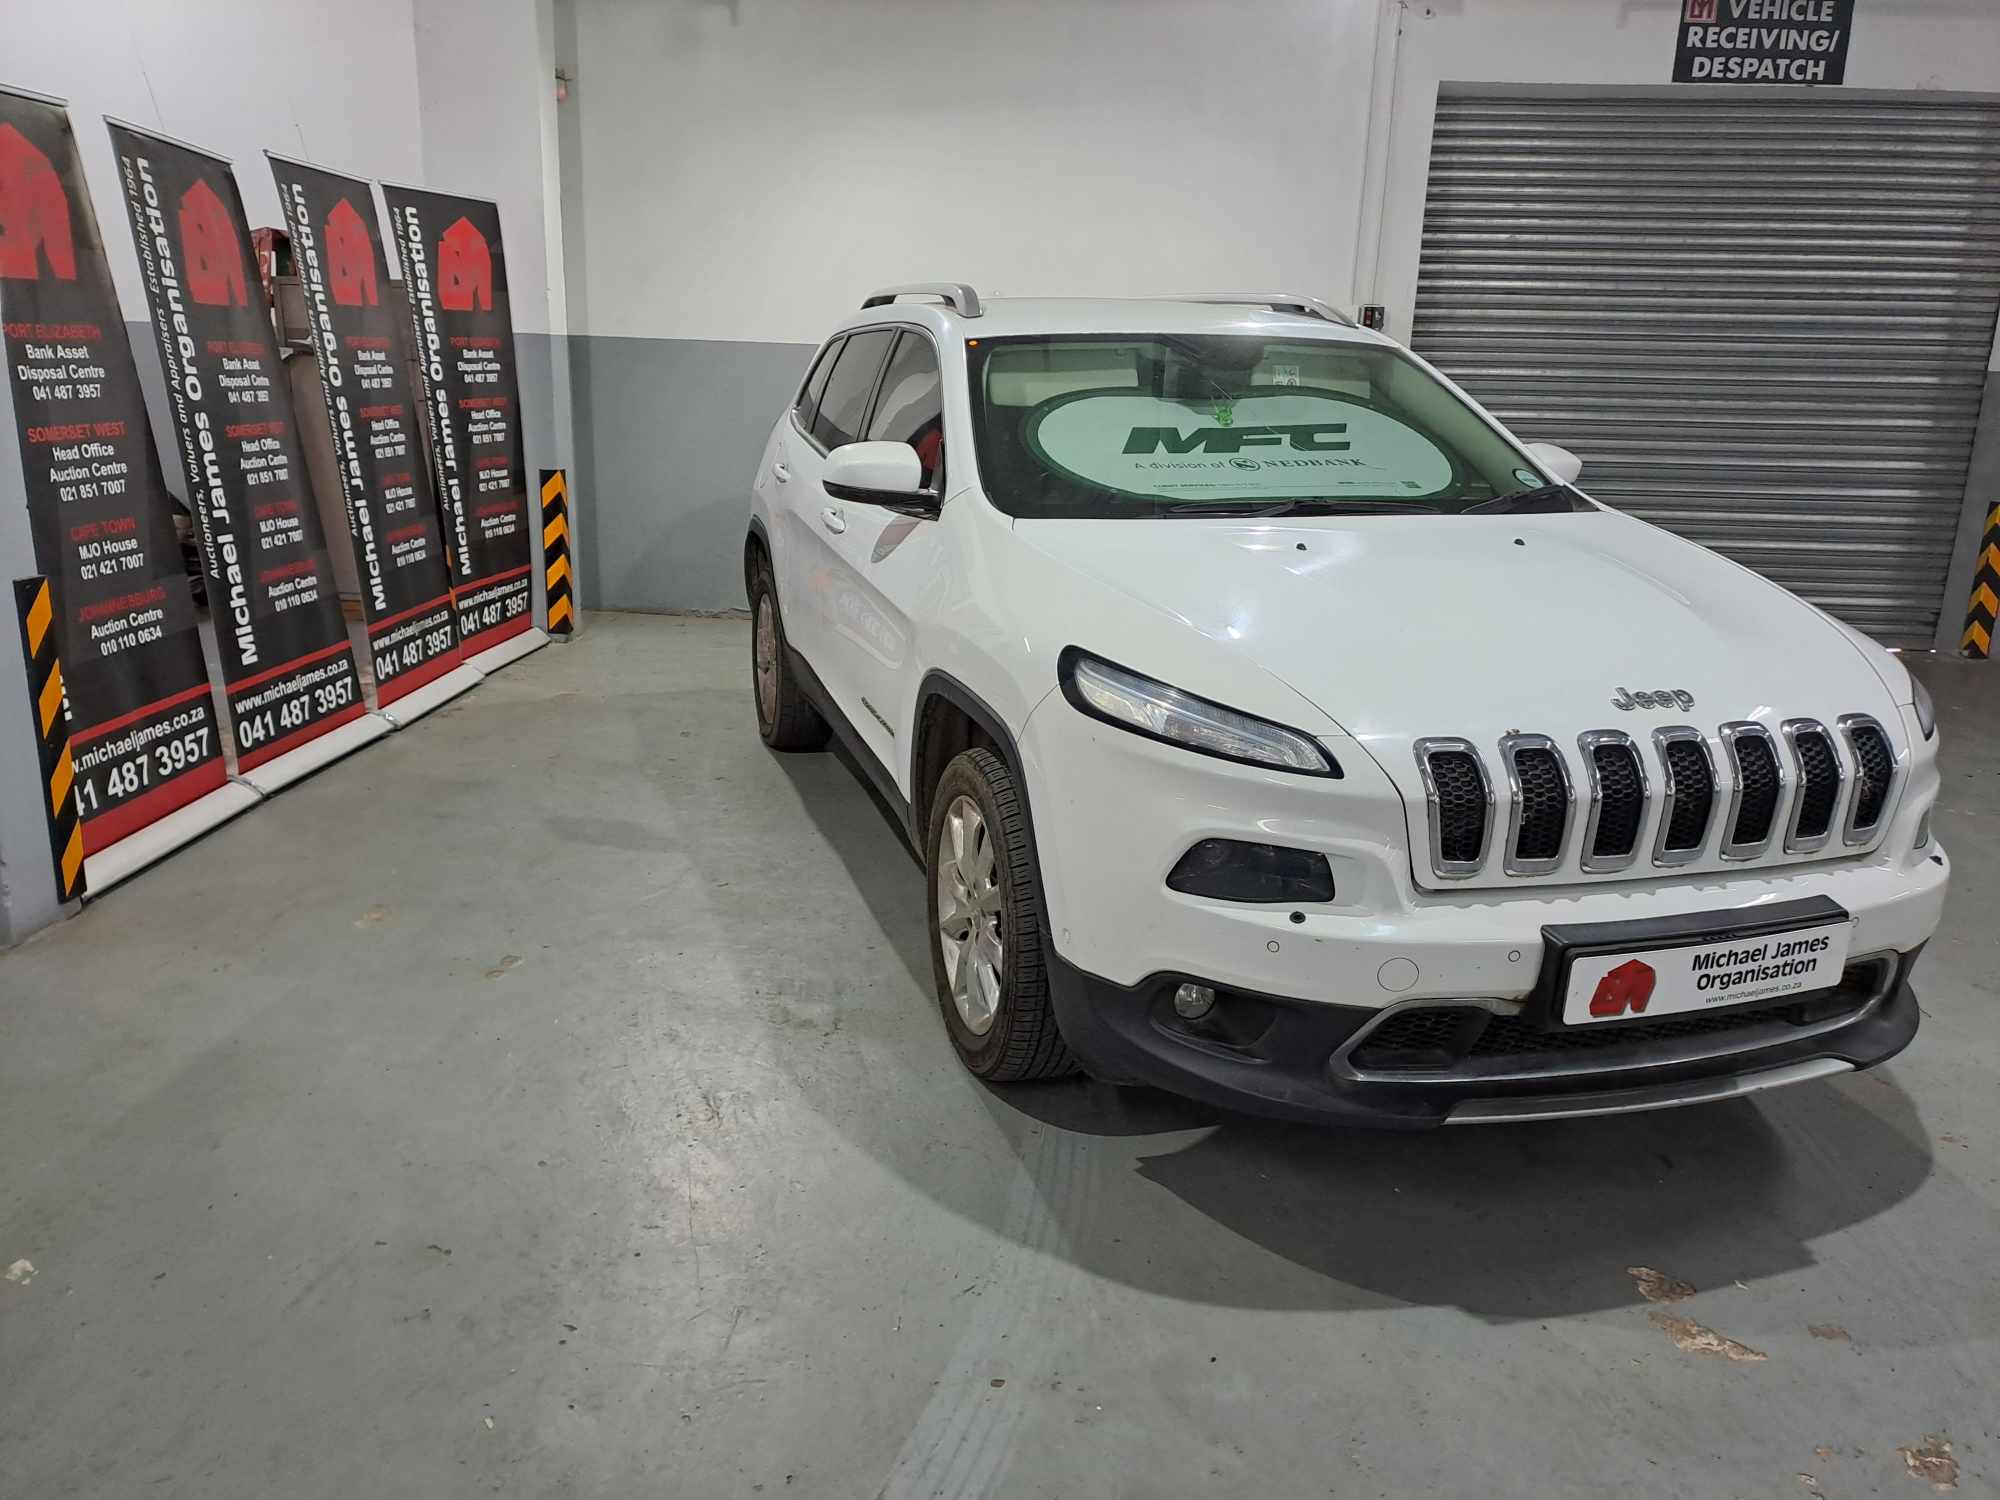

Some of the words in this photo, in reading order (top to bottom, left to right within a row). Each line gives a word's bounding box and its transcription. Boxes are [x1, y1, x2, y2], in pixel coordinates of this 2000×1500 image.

[1729, 0, 1834, 21] VEHICLE
[1686, 26, 1840, 52] RECEIVING/
[1691, 56, 1826, 81] DESPATCH
[130, 200, 159, 292] Established
[25, 344, 54, 359] Bank
[56, 344, 89, 359] Asset
[157, 307, 182, 389] Appraisers
[17, 365, 67, 382] Disposal
[69, 364, 105, 379] Centre
[218, 374, 251, 389] Disposal
[33, 386, 51, 401] 041
[54, 385, 72, 400] 487
[78, 383, 101, 398] 3957
[173, 393, 188, 424] and
[95, 421, 127, 437] WEST
[336, 395, 364, 491] James
[436, 389, 457, 472] James
[1122, 423, 1351, 454] MFC
[52, 446, 79, 462] Head
[81, 443, 114, 457] Office
[183, 427, 199, 484] Valuers
[195, 411, 231, 524] James
[1149, 460, 1202, 470] division
[1263, 457, 1367, 468] NEDBANK
[50, 466, 89, 483] Auction
[92, 461, 128, 477] Centre
[60, 487, 78, 502] 021
[79, 483, 98, 499] 851
[101, 479, 126, 495] 7007
[448, 478, 472, 576] Michael
[79, 543, 100, 560] MJO
[103, 537, 138, 554] House
[354, 499, 387, 611] Michael
[80, 564, 97, 580] 021
[100, 560, 118, 575] 421
[120, 553, 144, 571] 7007
[216, 534, 259, 666] Michael
[460, 610, 480, 635] 041
[482, 601, 501, 625] 487
[505, 591, 529, 617] 3957
[91, 618, 127, 640] Auction
[129, 608, 164, 627] Centre
[118, 633, 136, 651] 110
[140, 625, 162, 644] 0634
[376, 649, 400, 680] 041
[402, 638, 423, 666] 487
[425, 625, 452, 656] 3957
[234, 659, 349, 714] www.michaeljames.co.za
[1610, 687, 1695, 712] Jeep
[239, 710, 275, 747] 041
[280, 694, 310, 728] 487
[314, 675, 353, 713] 3957
[107, 754, 149, 799] 487
[155, 727, 209, 776] 3957
[1692, 942, 1768, 972] Michael
[1770, 935, 1830, 960] James
[1696, 955, 1817, 991] Organisation
[1704, 981, 1803, 1005] www.michaeljames.co.za
